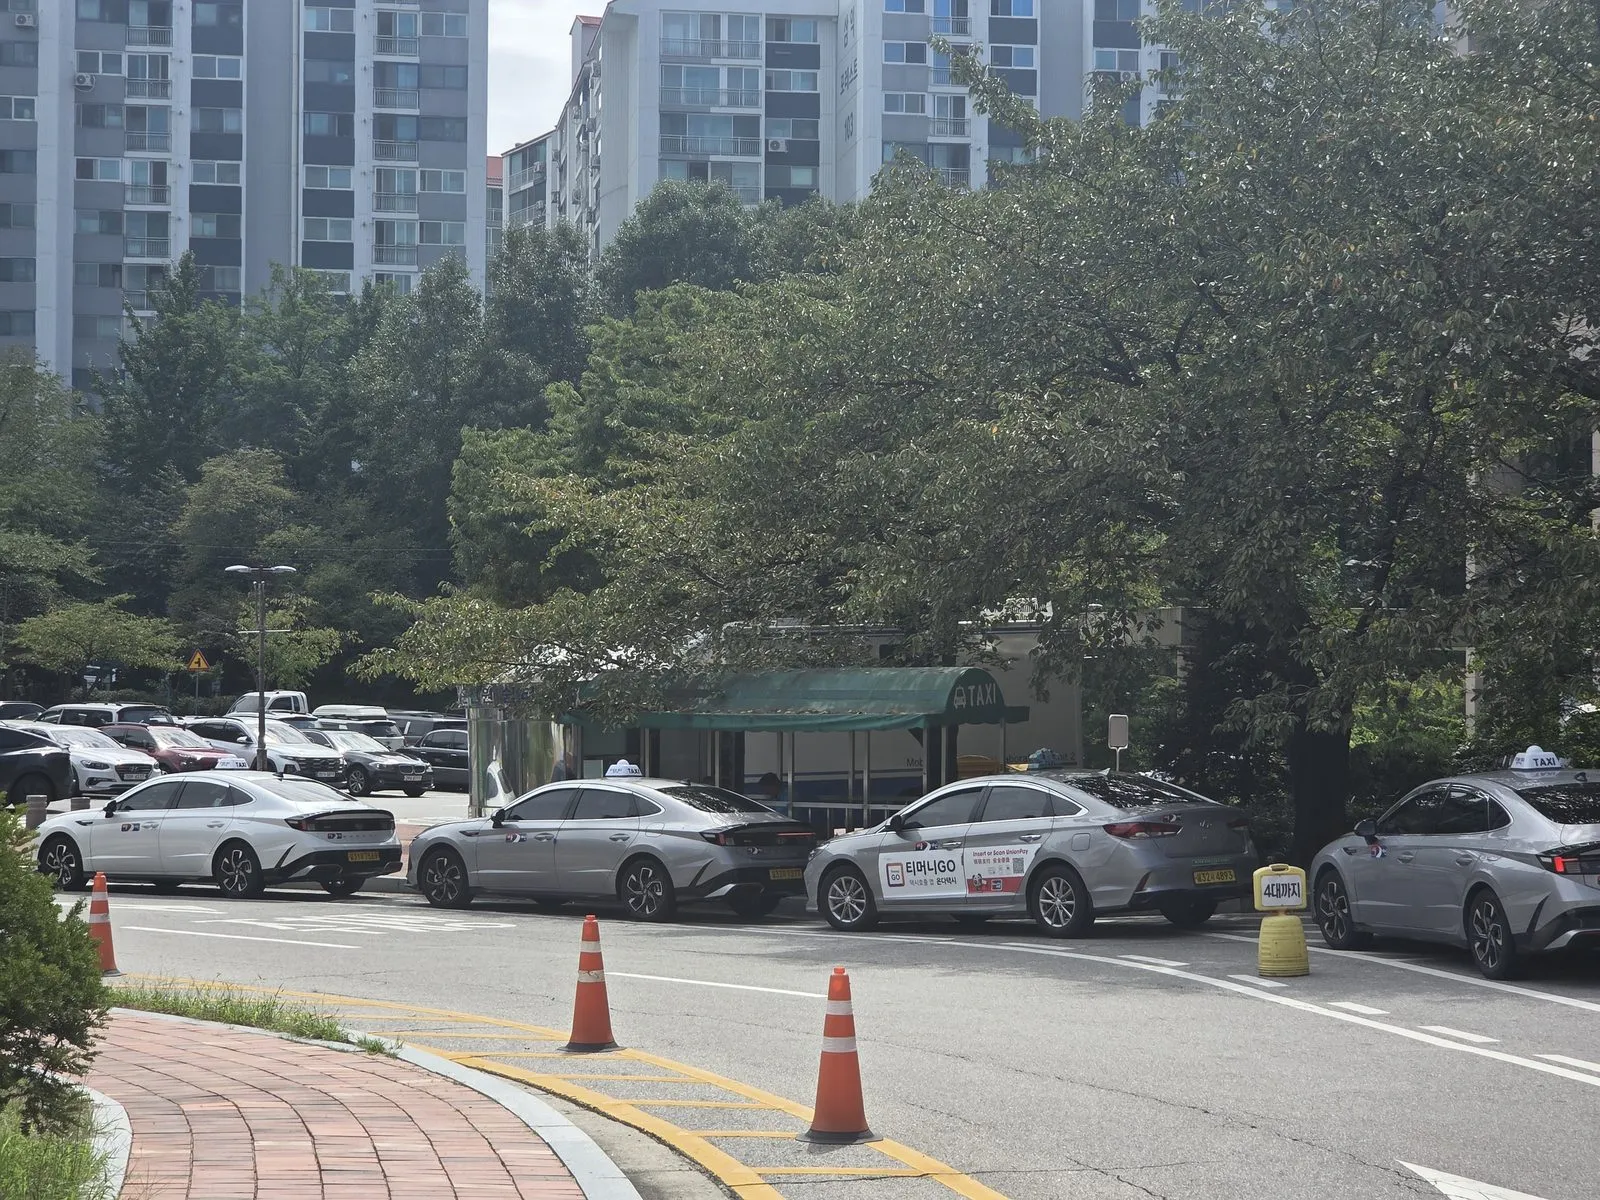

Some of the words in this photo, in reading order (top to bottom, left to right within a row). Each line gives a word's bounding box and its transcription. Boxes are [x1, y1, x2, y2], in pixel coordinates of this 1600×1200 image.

[844, 112, 853, 142] 103
[968, 683, 996, 707] TAXI
[1533, 757, 1556, 767] TAXI
[906, 860, 956, 876] 티머니GO
[1216, 870, 1233, 880] 4893
[1263, 882, 1301, 898] 4대까지
